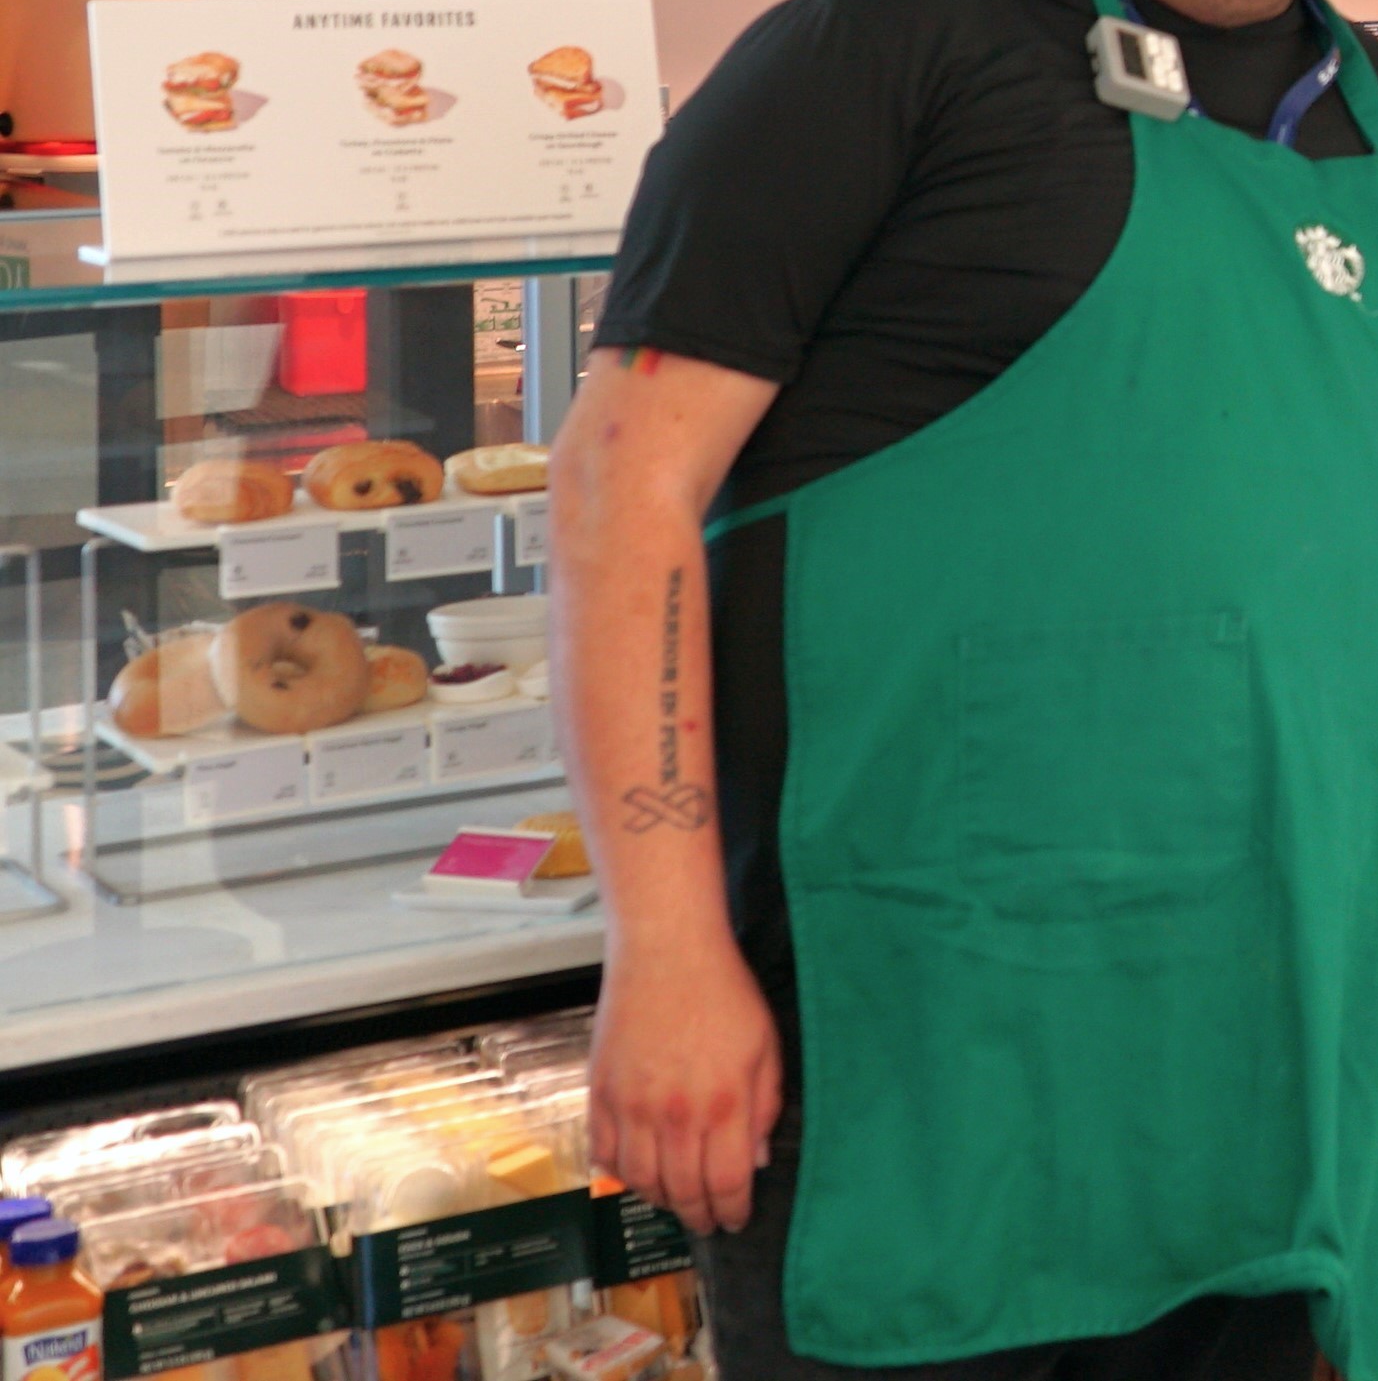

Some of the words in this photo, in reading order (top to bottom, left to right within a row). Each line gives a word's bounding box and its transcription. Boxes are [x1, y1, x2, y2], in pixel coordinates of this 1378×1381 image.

[293, 14, 375, 30] ANYTIME
[380, 11, 476, 29] FAVORITES
[27, 1333, 86, 1363] Naked
